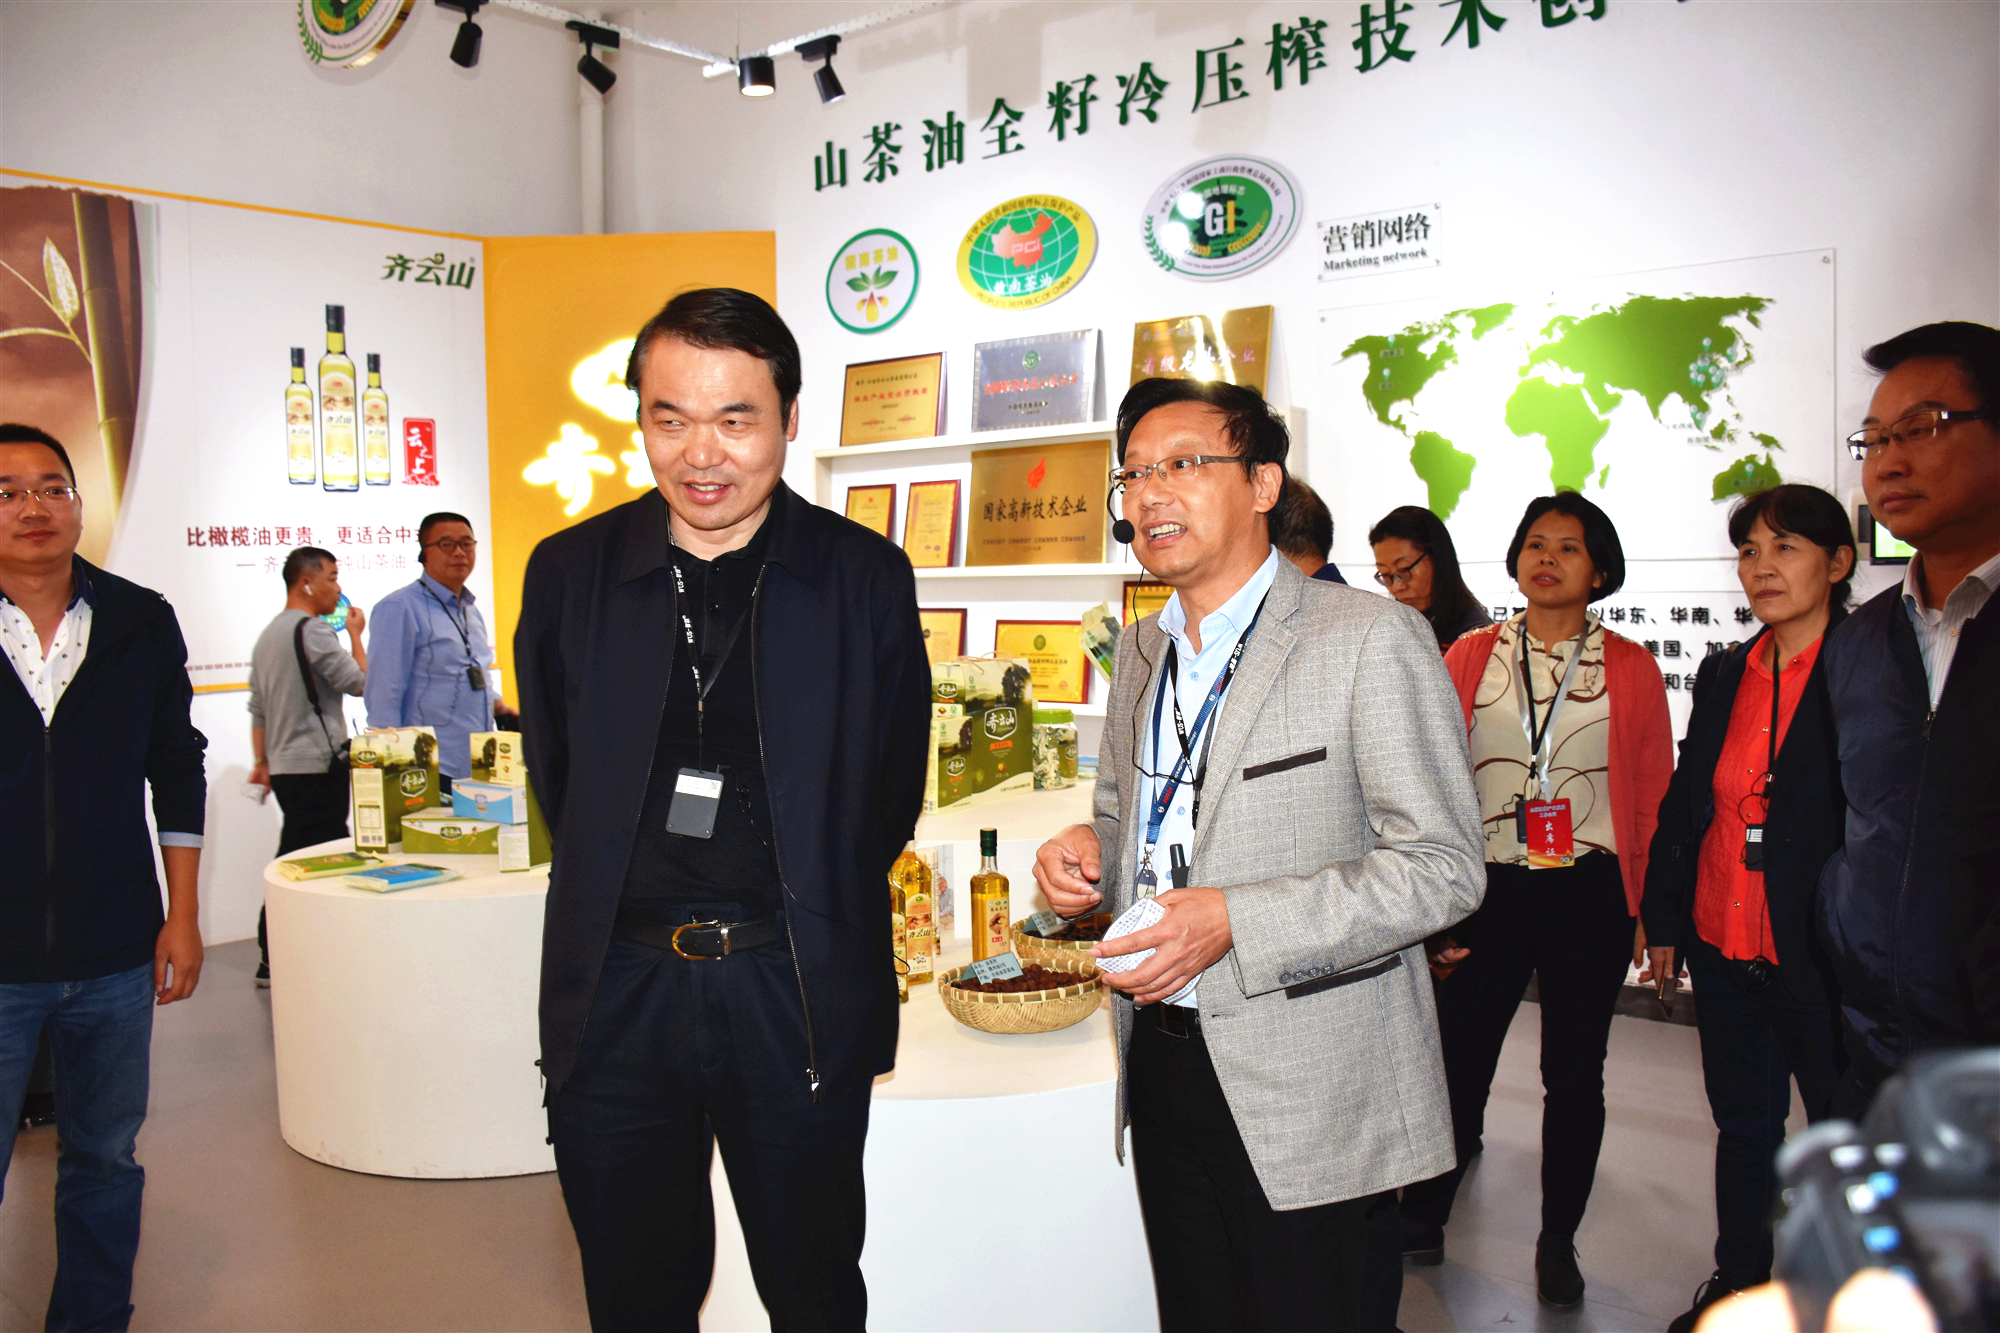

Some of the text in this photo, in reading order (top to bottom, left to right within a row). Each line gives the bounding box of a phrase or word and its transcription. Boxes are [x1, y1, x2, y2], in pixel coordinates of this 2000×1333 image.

[1204, 199, 1236, 237] GI
[1324, 212, 1432, 254] 营销网络
[1011, 238, 1041, 256] PGI
[1324, 247, 1429, 271] Marketing network
[381, 252, 476, 290] 齐云山
[983, 494, 1087, 522] 国家高新技术企业
[1545, 820, 1556, 856] 出席证
